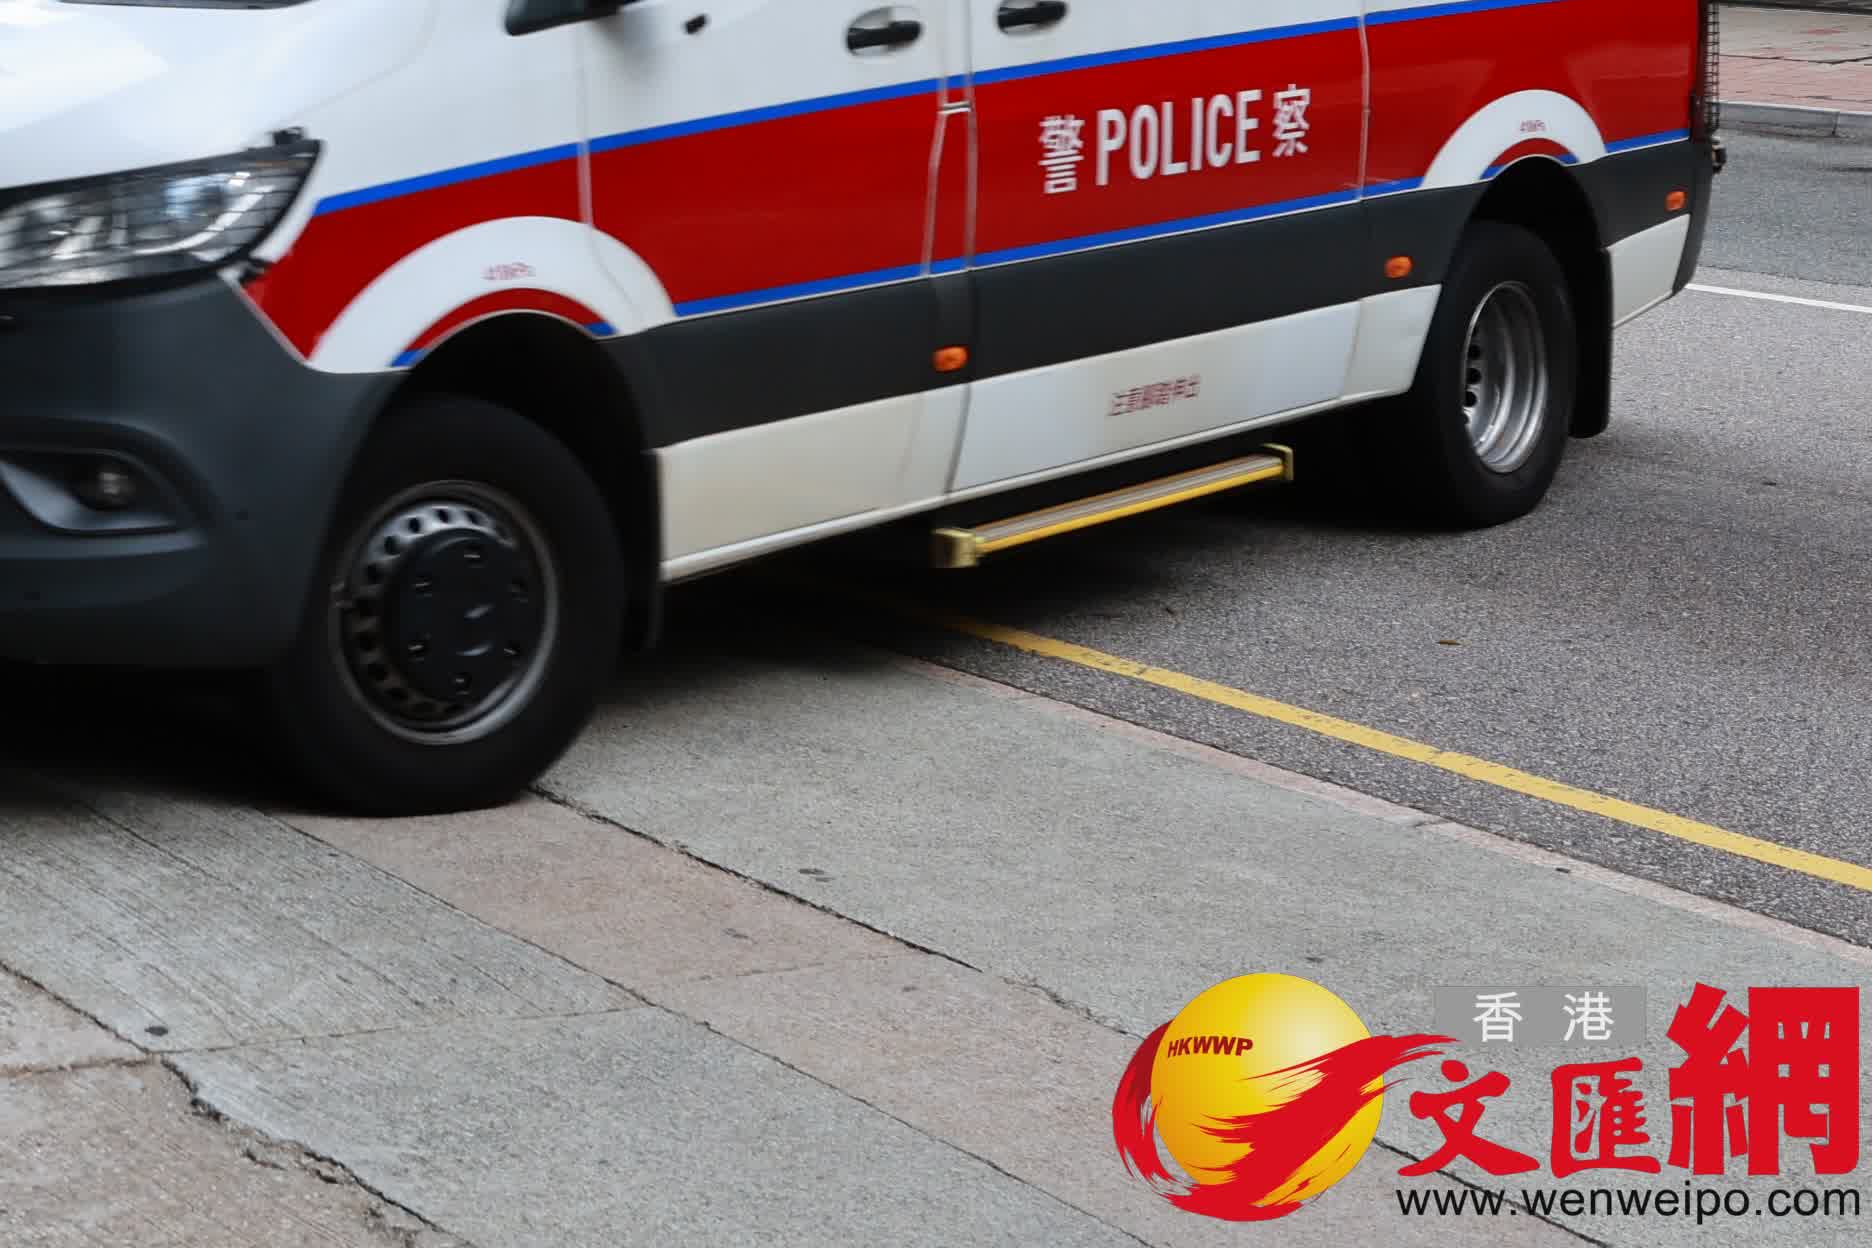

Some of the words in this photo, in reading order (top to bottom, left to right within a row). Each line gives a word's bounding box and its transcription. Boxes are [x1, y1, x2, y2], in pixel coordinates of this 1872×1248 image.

[1039, 115, 1085, 194] 警
[1095, 89, 1262, 187] POLICE
[1273, 83, 1311, 157] 察
